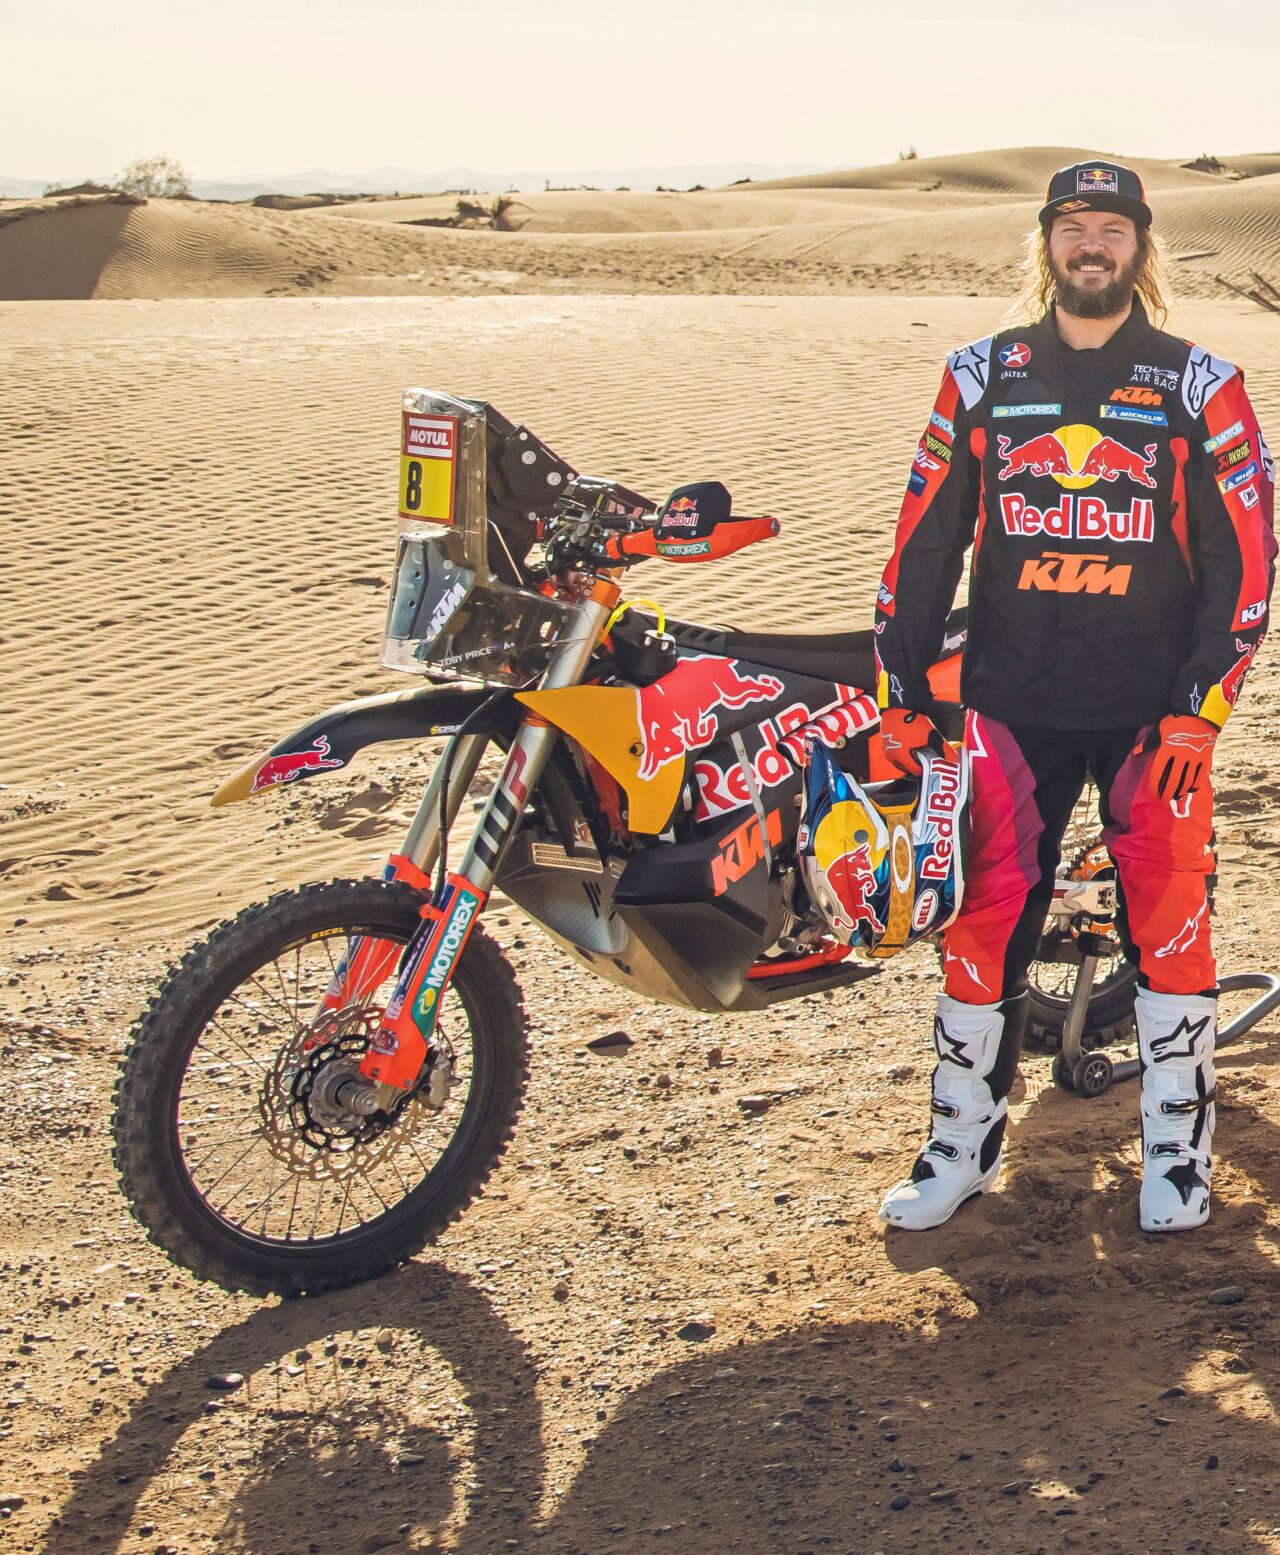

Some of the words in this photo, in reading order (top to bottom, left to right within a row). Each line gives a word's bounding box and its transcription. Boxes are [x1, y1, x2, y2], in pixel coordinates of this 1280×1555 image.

[1000, 371, 1028, 379] CALTEX
[1131, 373, 1151, 382] AIR
[1153, 375, 1177, 391] BAG
[1009, 404, 1058, 415] MOTOREX
[1109, 386, 1163, 406] KTM
[1119, 410, 1163, 421] MICHELIN
[410, 430, 448, 445] MOTUL
[406, 461, 422, 510] 8
[1001, 493, 1073, 538] Red
[1077, 497, 1154, 542] Bull
[665, 542, 708, 555] MOTOREX
[1017, 552, 1132, 595] KTM
[426, 582, 467, 640] KTM
[465, 647, 492, 661] PRICE
[697, 720, 794, 822] Red
[929, 758, 960, 814] Bull
[710, 809, 783, 897] KTM
[920, 814, 954, 880] Red
[917, 892, 933, 925] BELL
[311, 927, 345, 940] EXCEL
[427, 897, 477, 988] MOTOREX
